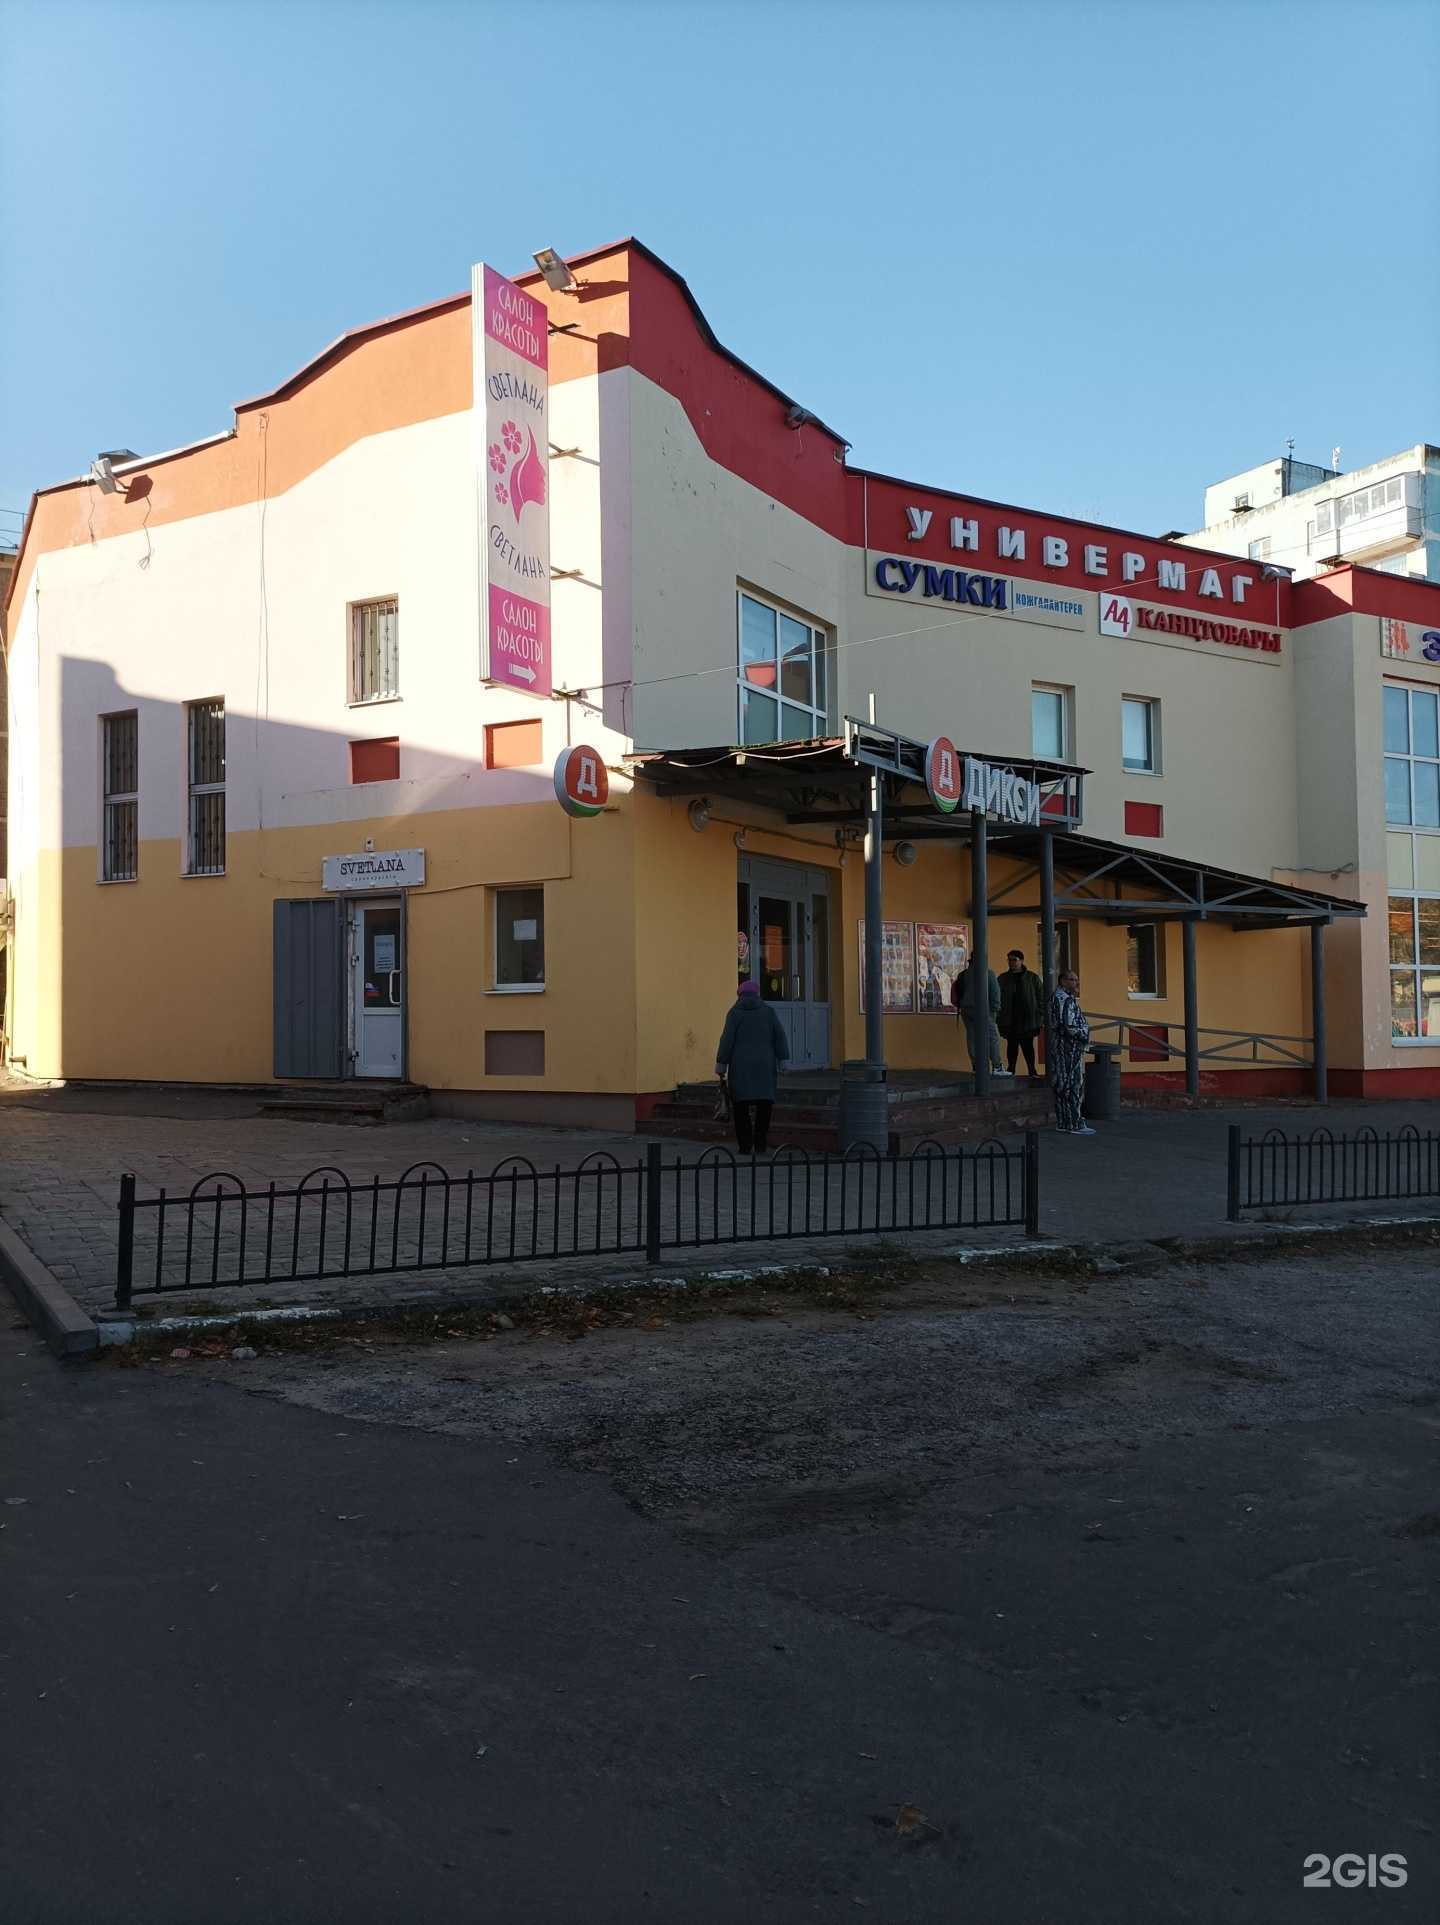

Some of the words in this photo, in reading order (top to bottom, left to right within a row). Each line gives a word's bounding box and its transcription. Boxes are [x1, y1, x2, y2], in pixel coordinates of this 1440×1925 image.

[497, 285, 534, 329] САЛОН
[492, 309, 540, 361] КРАСОТЫ
[488, 372, 545, 416] СВЕТЛАНА
[490, 524, 546, 578] СВЕТЛАНА
[905, 506, 1253, 604] УНИВЕРМАГ
[875, 558, 1008, 611] СУМКИ
[502, 599, 537, 634] САЛОН
[1137, 607, 1282, 653] КАНЦТОВАРЫ
[496, 627, 544, 665] КРАСОТЫ
[340, 858, 406, 875] SVETLANA
